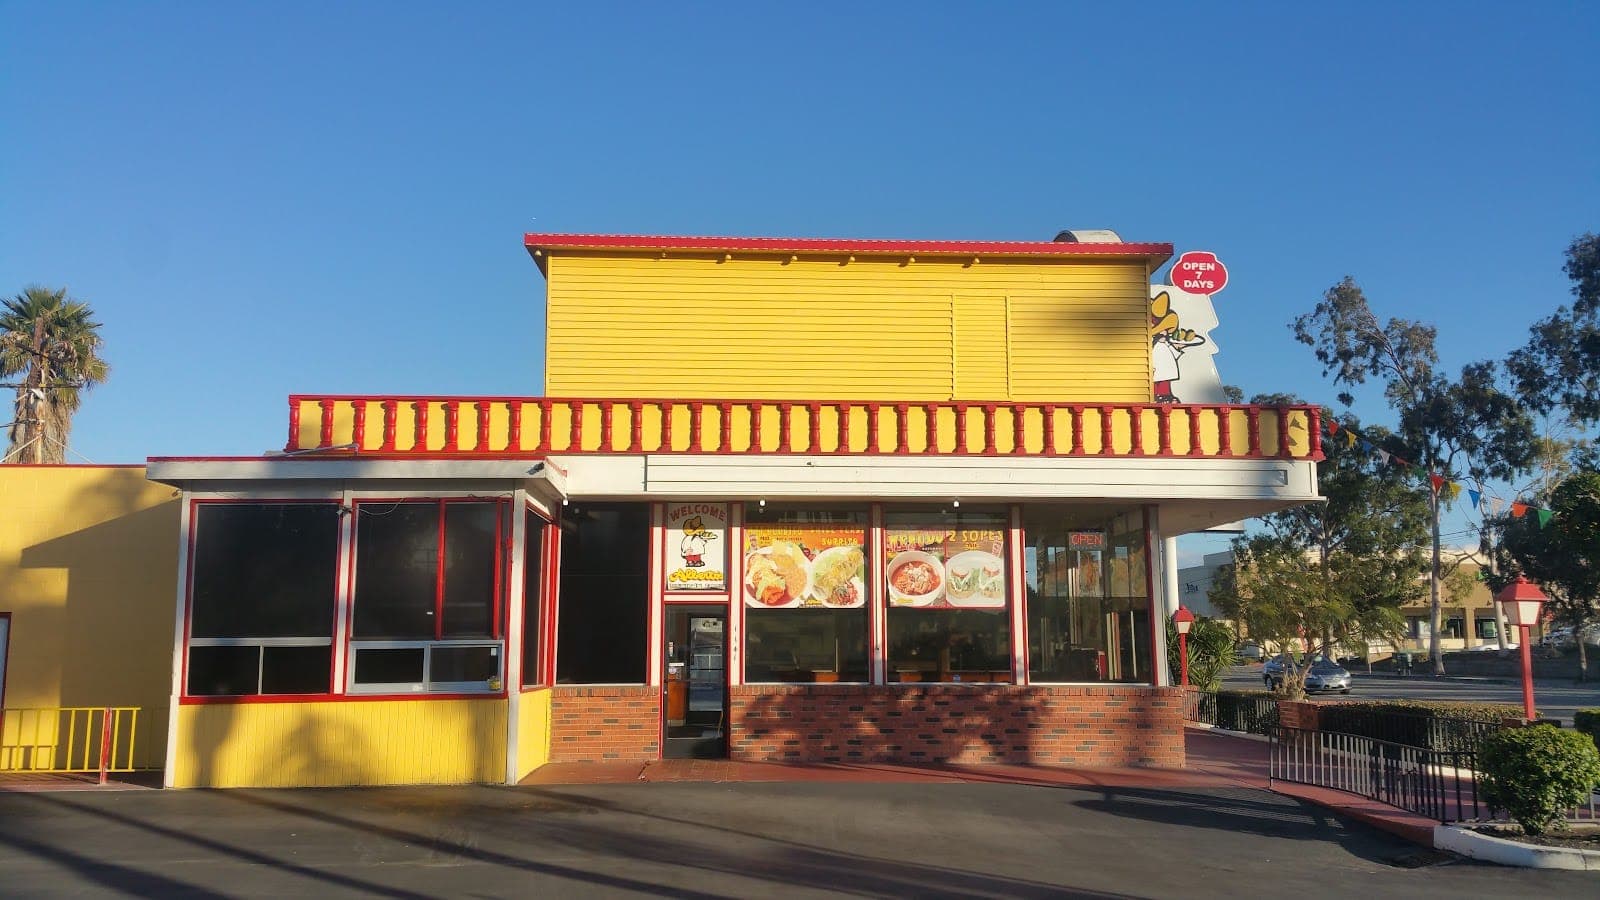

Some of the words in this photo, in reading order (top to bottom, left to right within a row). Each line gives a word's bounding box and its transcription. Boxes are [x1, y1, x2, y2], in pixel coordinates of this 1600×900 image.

[1183, 262, 1215, 271] OPEN
[1195, 271, 1203, 280] 7
[1184, 280, 1214, 289] DAYS
[669, 504, 727, 522] WELCOME
[949, 529, 957, 541] 2
[962, 529, 1004, 542] SOPES
[1072, 534, 1102, 545] OPEN
